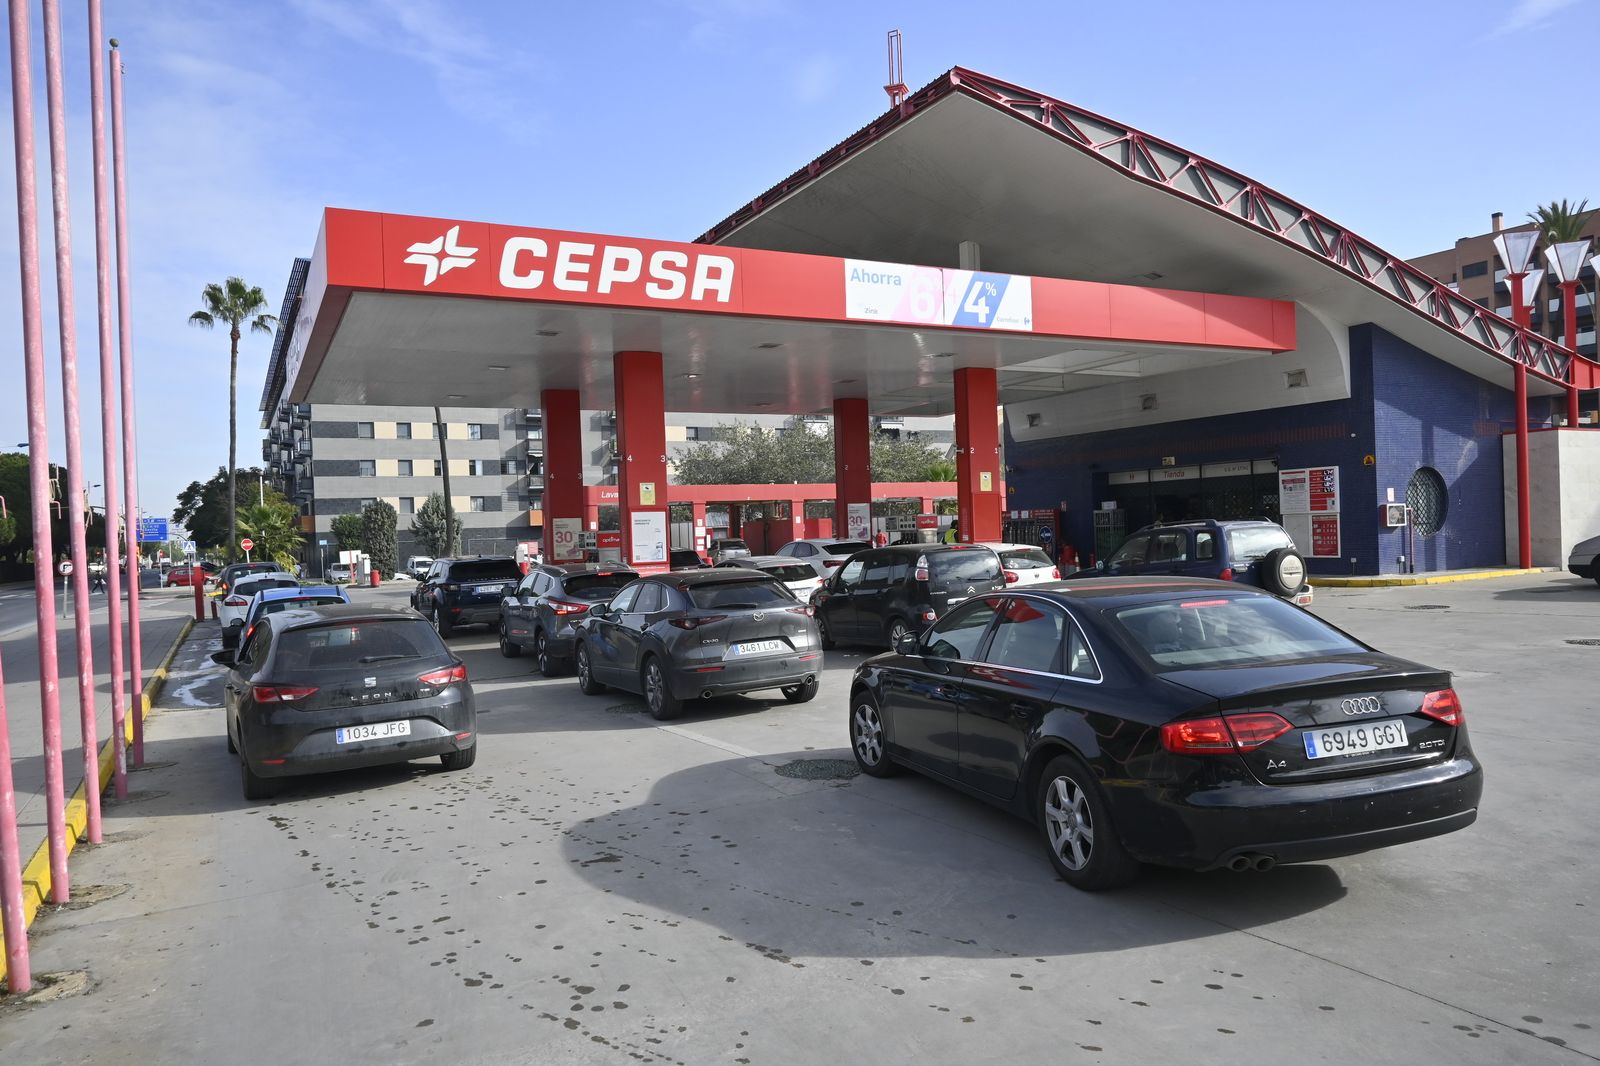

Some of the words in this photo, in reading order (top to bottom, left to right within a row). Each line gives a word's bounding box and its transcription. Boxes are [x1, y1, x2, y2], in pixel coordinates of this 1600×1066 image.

[499, 237, 735, 303] CEPSA
[850, 268, 902, 286] Ahorra
[627, 454, 633, 462] 4
[660, 454, 666, 462] 3
[1164, 471, 1185, 479] Tienda
[848, 515, 863, 527] 30
[555, 531, 573, 543] 30
[740, 643, 761, 653] 3461
[763, 641, 780, 651] LCW
[350, 692, 392, 701] LEON
[346, 726, 378, 740] 1034
[383, 722, 406, 735] JFG
[1322, 728, 1369, 753] 6949
[1373, 722, 1404, 746] GGY
[1266, 759, 1287, 770] A4
